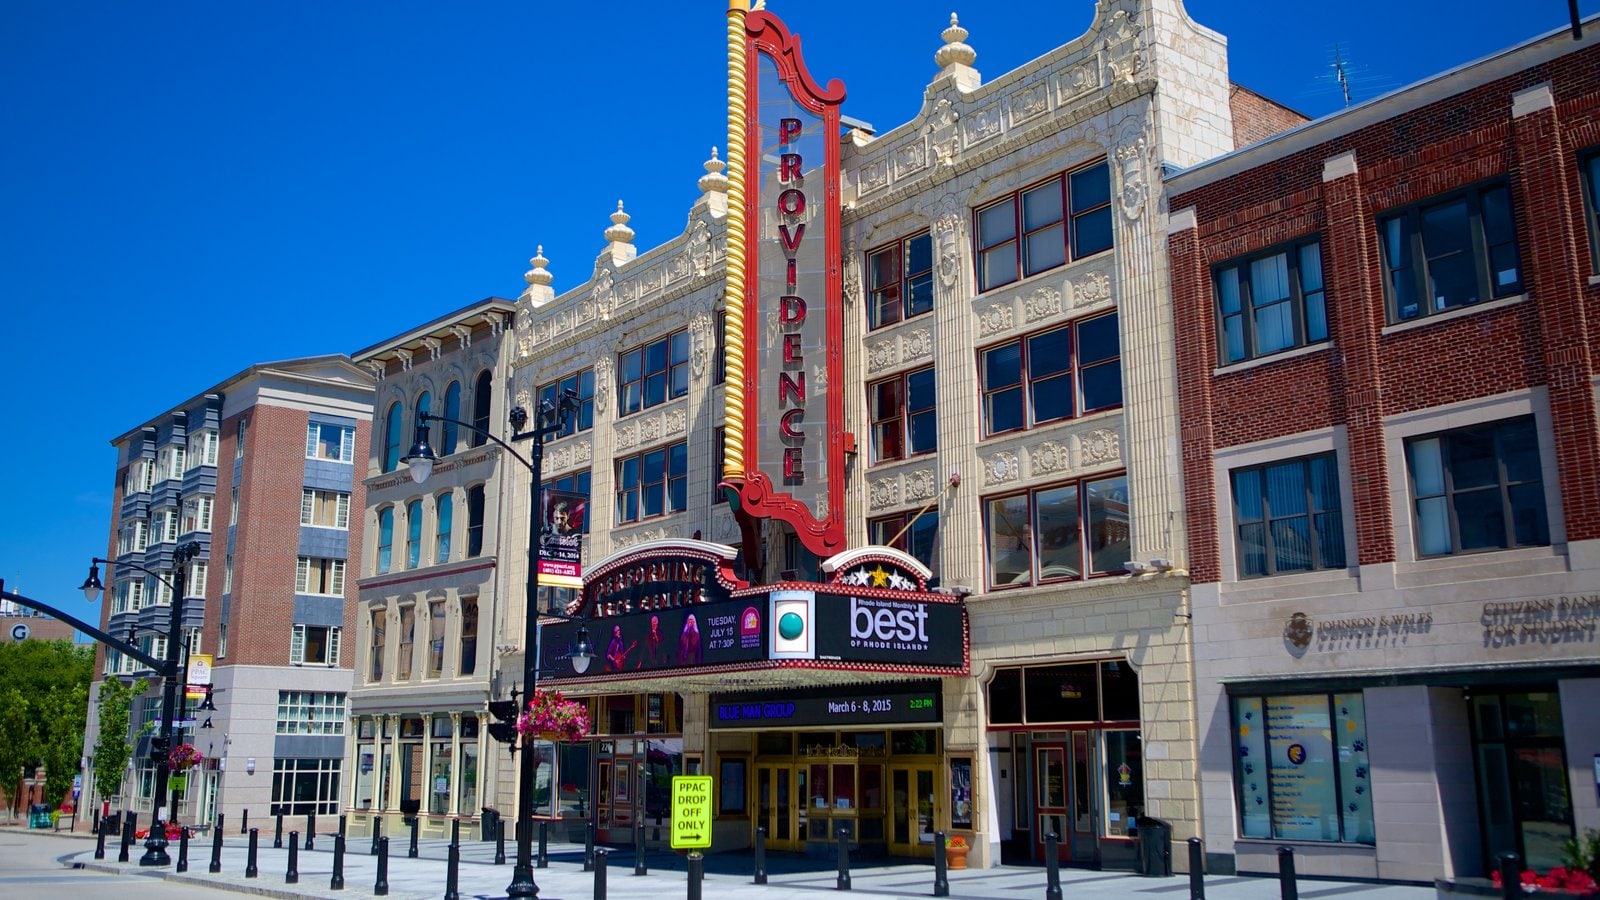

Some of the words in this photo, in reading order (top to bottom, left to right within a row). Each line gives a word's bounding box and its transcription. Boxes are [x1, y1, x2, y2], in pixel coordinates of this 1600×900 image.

[777, 117, 807, 480] PROVIDENCE
[594, 561, 707, 601] PERFORMING
[639, 587, 708, 610] CENTER
[858, 599, 876, 607] Rhode
[1483, 599, 1555, 616] CITIZENS
[708, 615, 737, 626] TUESDAY,
[850, 597, 929, 642] best
[1317, 617, 1376, 632] JOHNSON
[1391, 611, 1434, 625] WALES
[12, 625, 27, 640] G
[710, 629, 725, 638] JULY
[726, 626, 734, 636] 15
[1486, 624, 1519, 636] FOR
[709, 640, 717, 649] AT
[718, 638, 735, 648] 7:30P
[850, 640, 861, 648] OF
[863, 641, 891, 649] RHODE
[893, 643, 922, 651] ISLAND
[828, 701, 849, 713] March
[851, 701, 856, 711] 6
[862, 700, 870, 713] 8,
[872, 699, 891, 711] 2015
[909, 699, 923, 708] 2:22
[923, 698, 932, 707] PM
[719, 705, 740, 719] BLUE
[742, 704, 761, 719] MAN
[763, 703, 795, 718] GROUP
[679, 782, 705, 792] PPAC
[678, 795, 706, 804] DROP
[682, 808, 702, 817] OFF
[678, 821, 705, 830] ONLY
